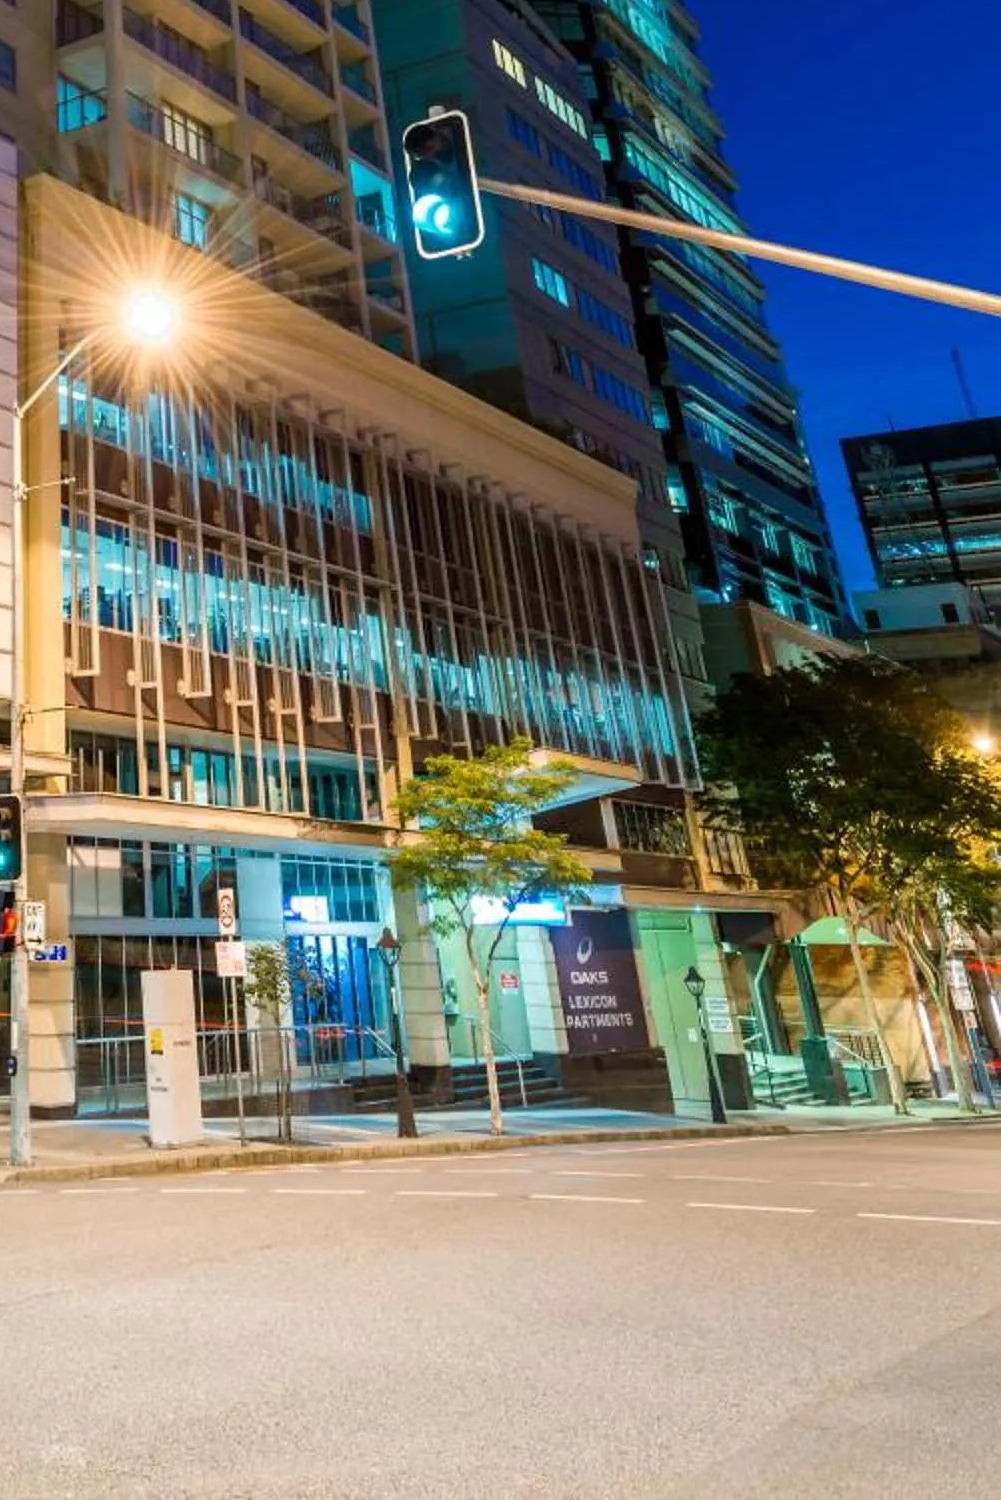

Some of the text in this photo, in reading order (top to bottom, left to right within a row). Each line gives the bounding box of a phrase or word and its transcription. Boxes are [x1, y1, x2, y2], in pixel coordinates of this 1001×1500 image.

[570, 971, 609, 985] OAKS
[568, 995, 617, 1009] LEXICON
[566, 1012, 633, 1028] PARTMENTS
